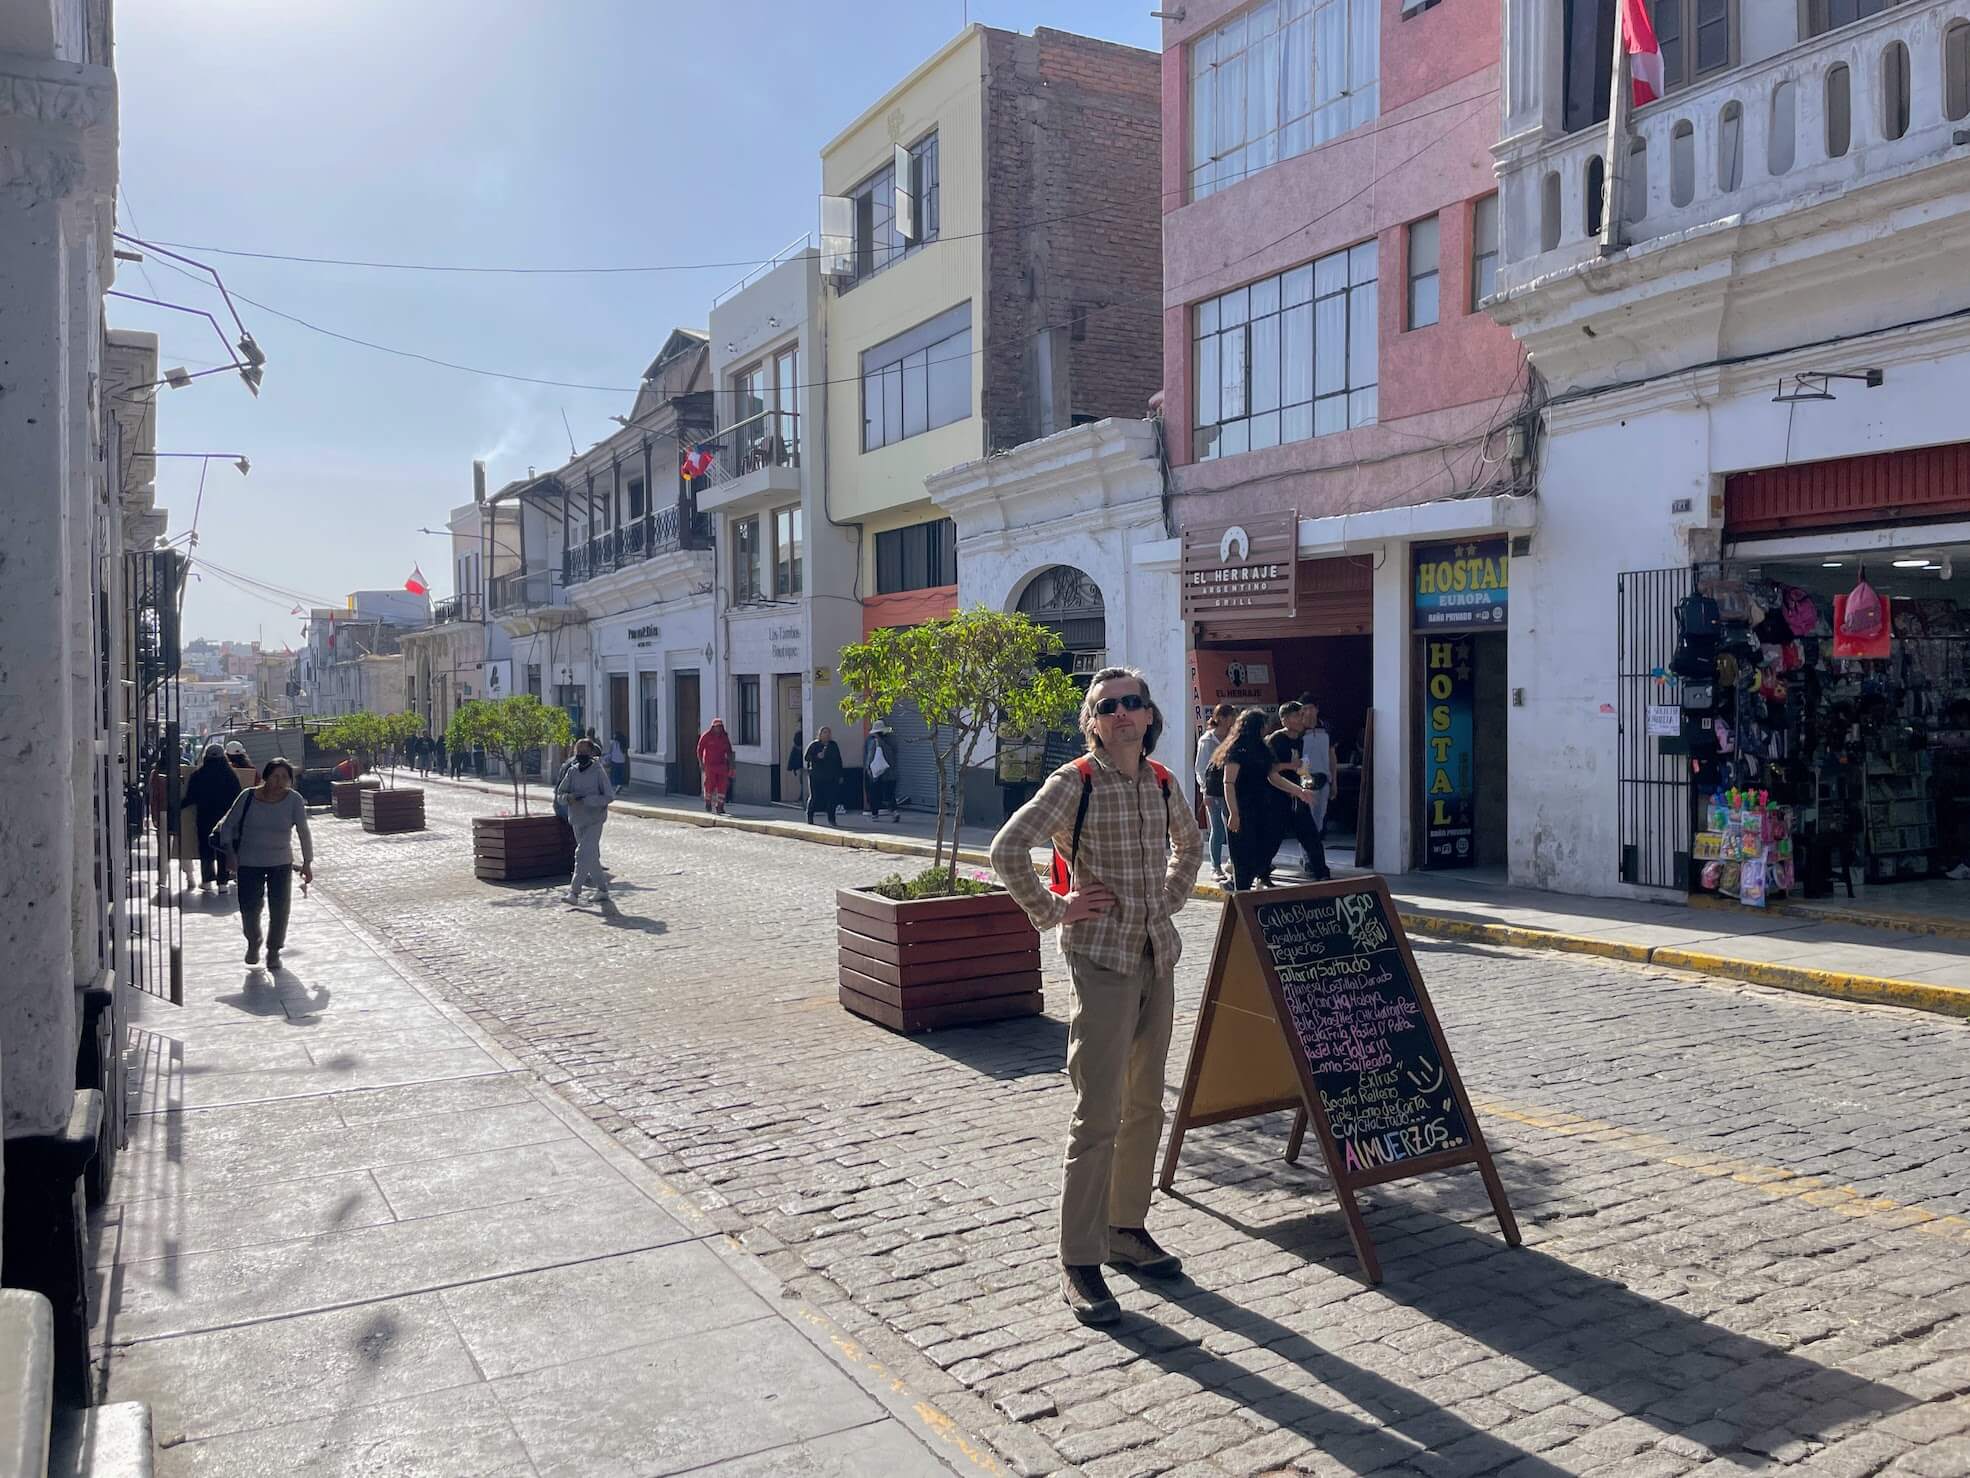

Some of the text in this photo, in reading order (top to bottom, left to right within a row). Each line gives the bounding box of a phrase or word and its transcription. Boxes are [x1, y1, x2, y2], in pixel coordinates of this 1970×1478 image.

[1194, 565, 1277, 584] EL HERRAJE
[1203, 583, 1267, 593] ARGENTINO
[1216, 598, 1252, 606] GRILL
[1440, 593, 1491, 606] EUROPA
[1430, 643, 1453, 825] HOSTAL
